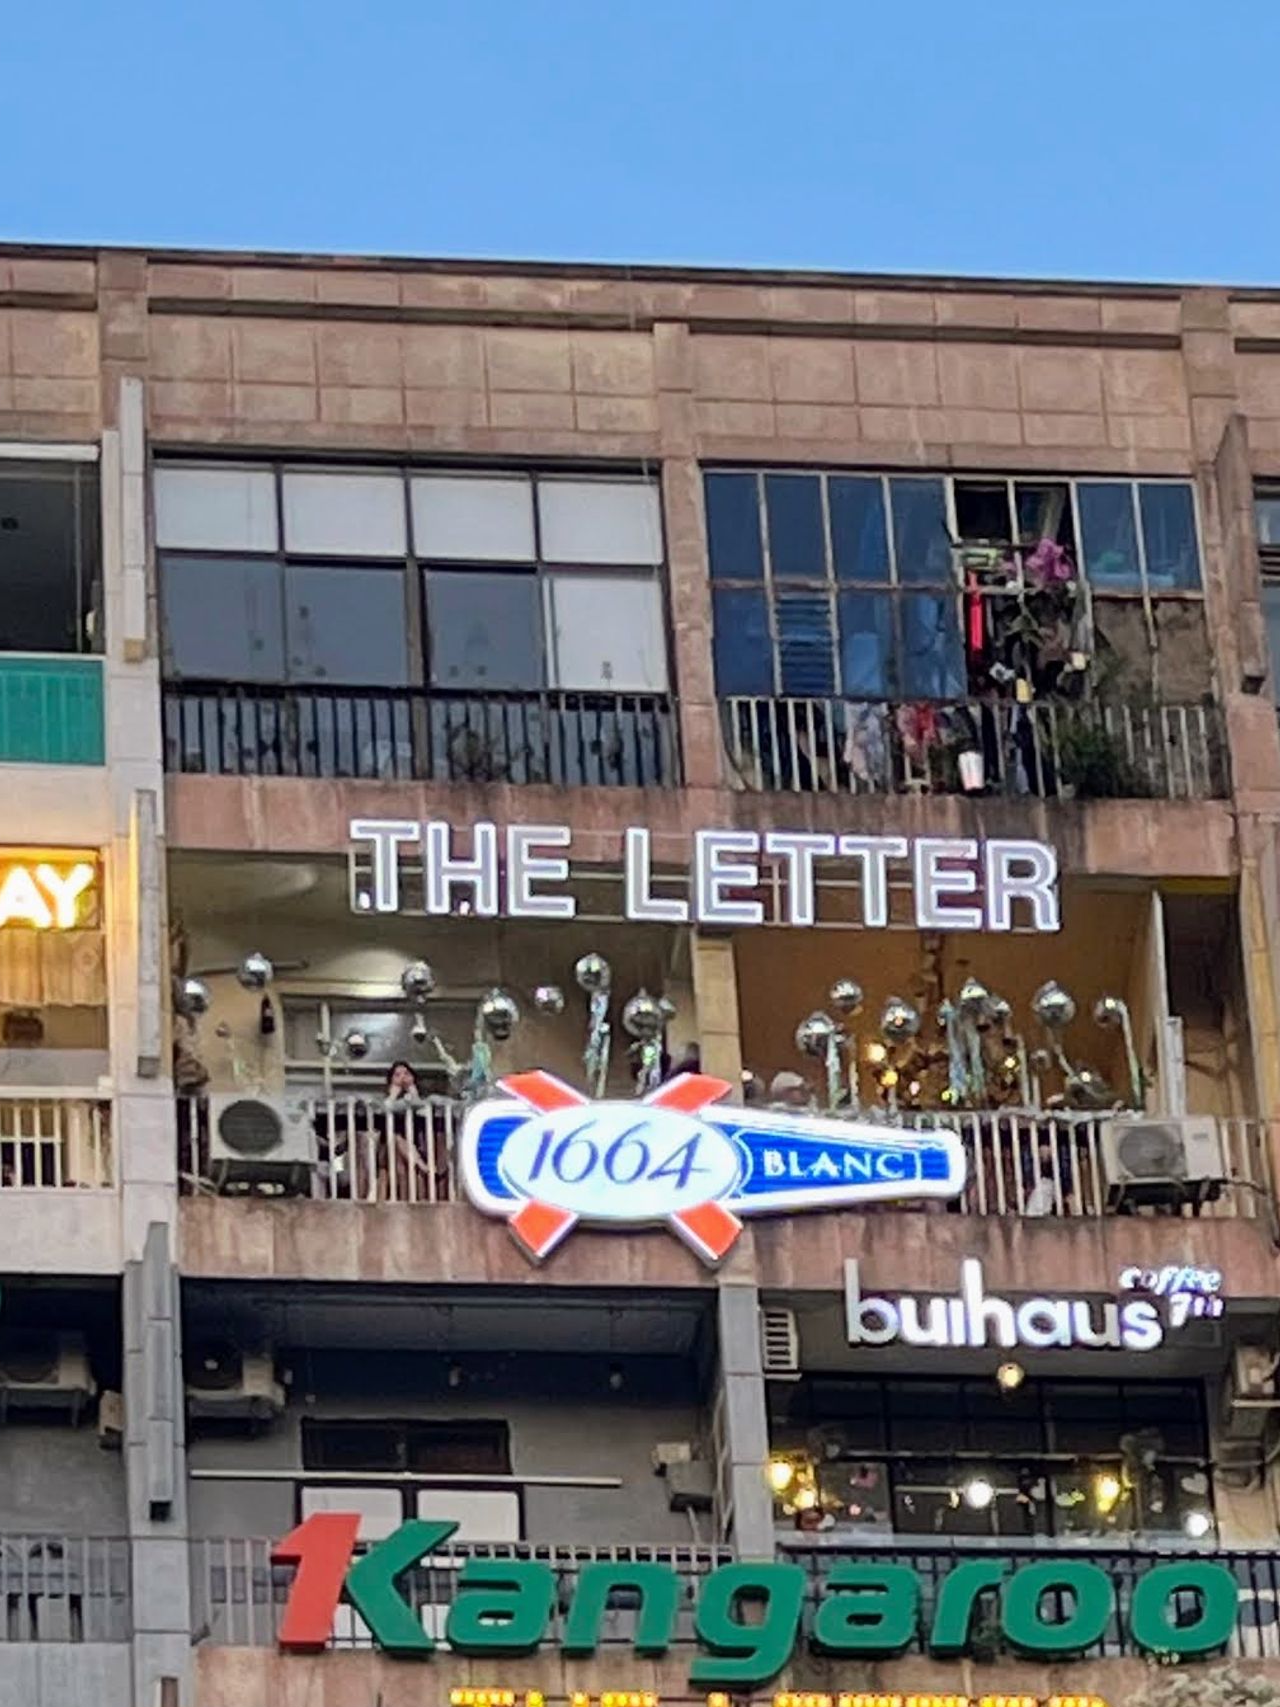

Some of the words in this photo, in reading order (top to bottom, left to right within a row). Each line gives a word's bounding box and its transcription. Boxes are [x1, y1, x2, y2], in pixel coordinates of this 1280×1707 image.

[350, 819, 577, 920] THE
[626, 827, 1059, 931] LETTER
[525, 1125, 711, 1187] 1664
[764, 1147, 906, 1180] BLANC
[844, 1258, 1163, 1351] buihaus
[1120, 1265, 1222, 1295] coffee
